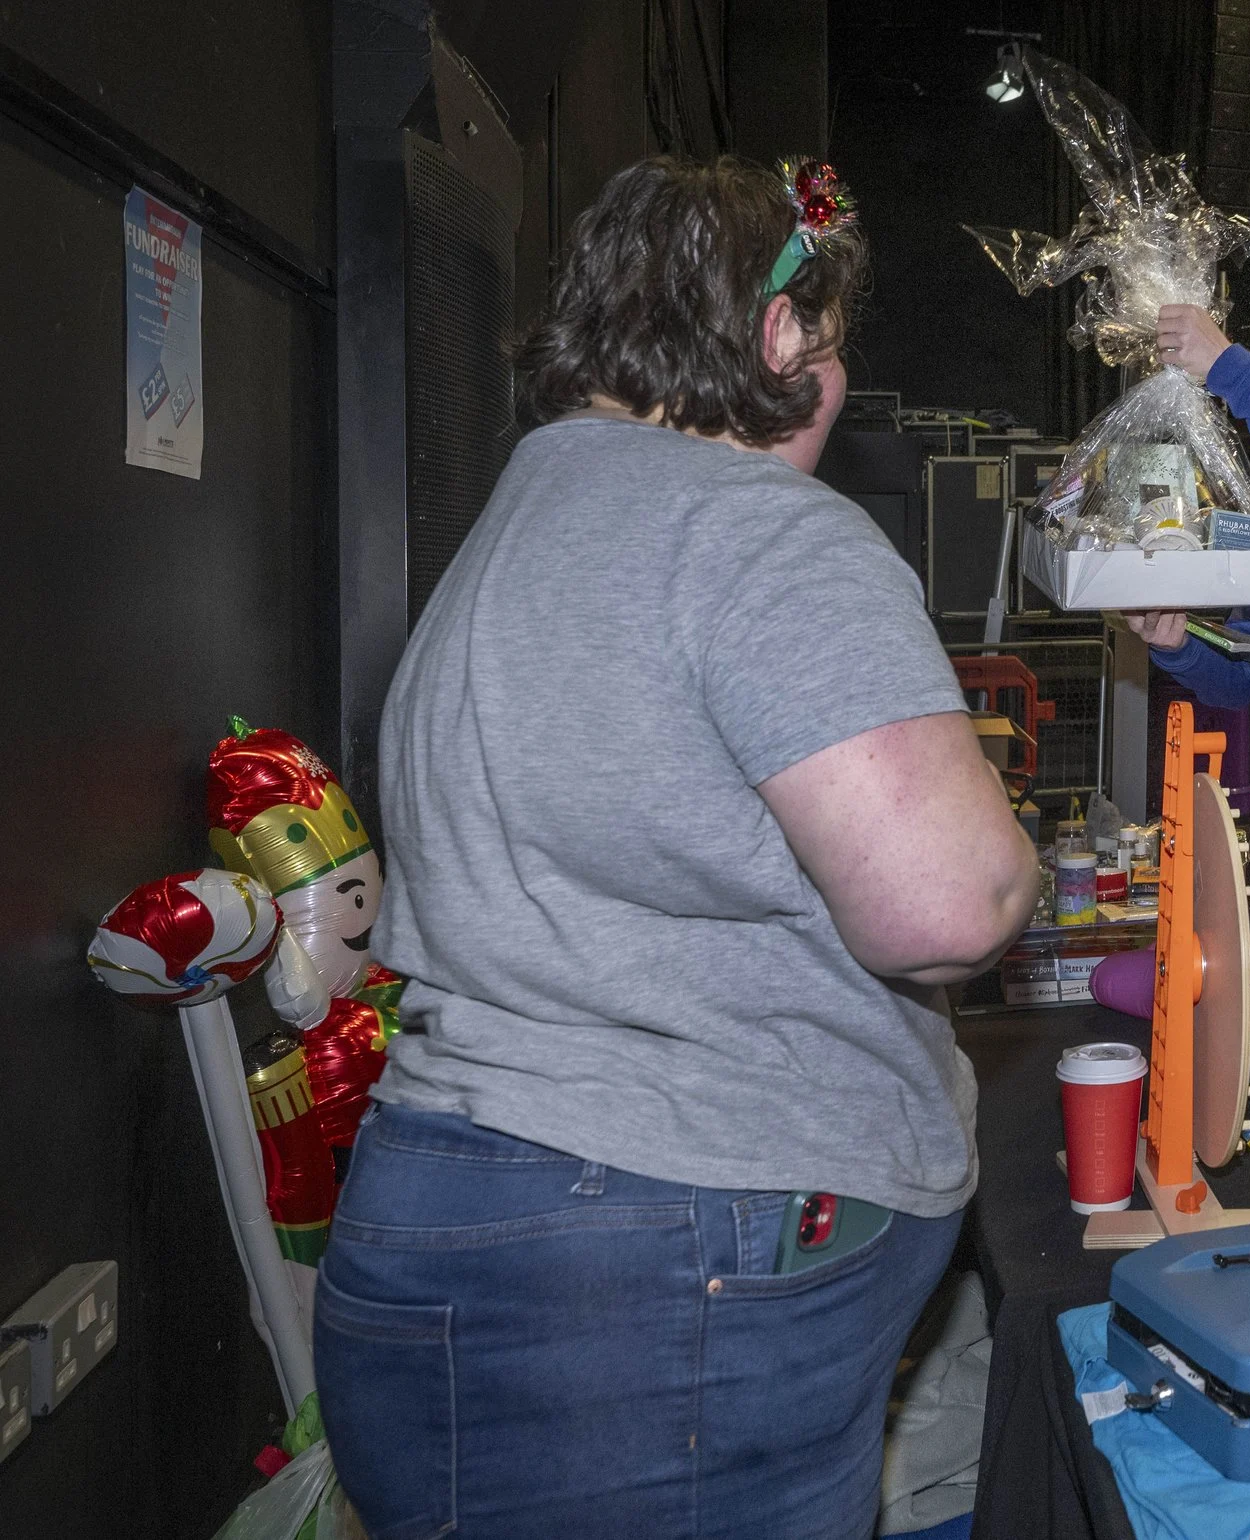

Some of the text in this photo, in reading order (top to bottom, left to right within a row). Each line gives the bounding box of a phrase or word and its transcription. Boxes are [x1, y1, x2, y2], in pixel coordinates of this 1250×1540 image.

[125, 220, 199, 281] FUNDRAISER
[142, 380, 157, 413] £2
[1065, 964, 1085, 974] MARK
